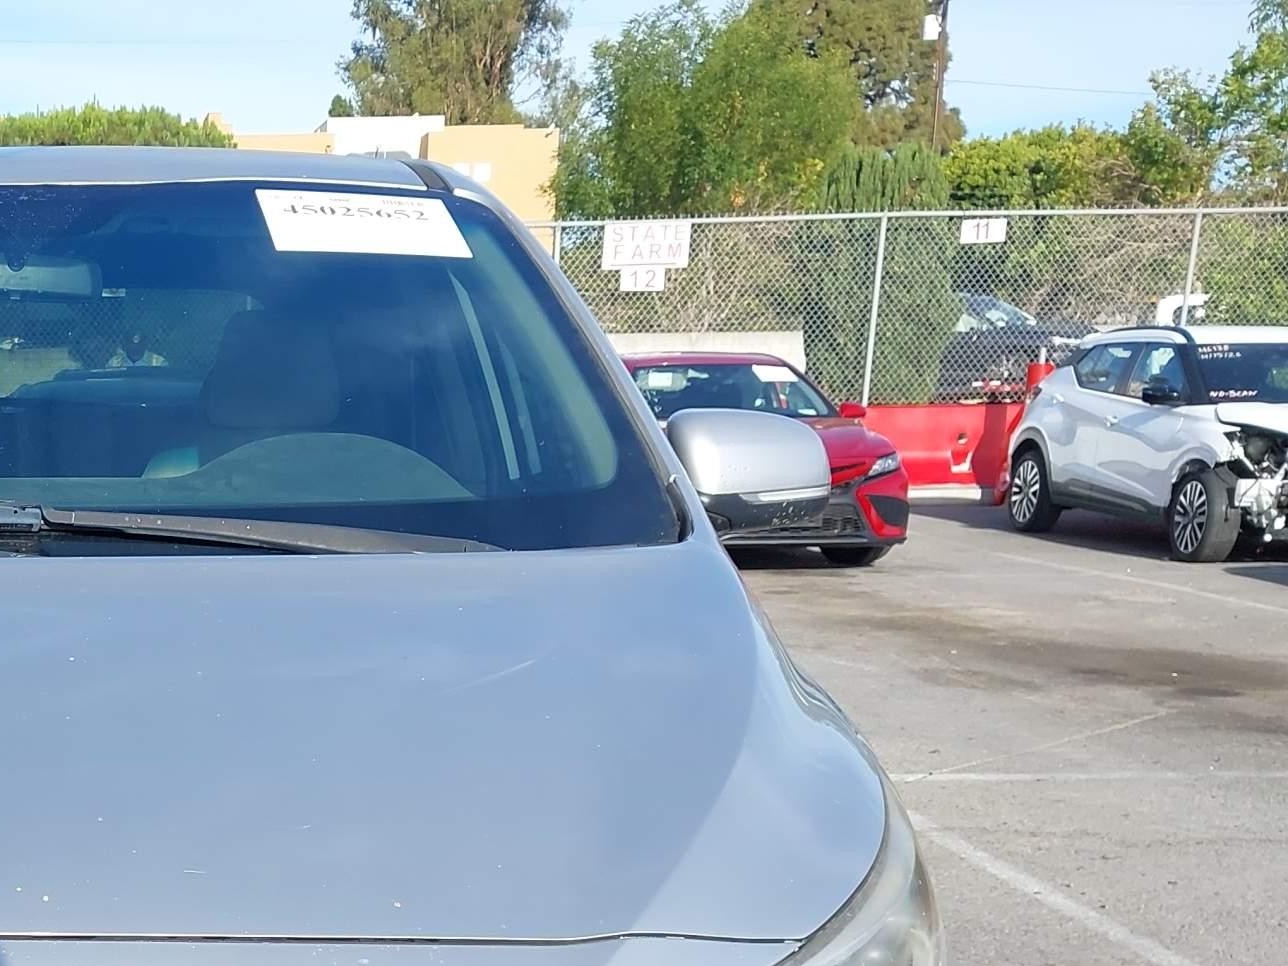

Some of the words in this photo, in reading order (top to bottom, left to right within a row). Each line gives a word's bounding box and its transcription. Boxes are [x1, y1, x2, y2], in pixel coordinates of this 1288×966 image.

[612, 224, 686, 242] STATE
[972, 221, 990, 240] 11
[614, 243, 682, 260] FARM
[630, 269, 657, 288] 12
